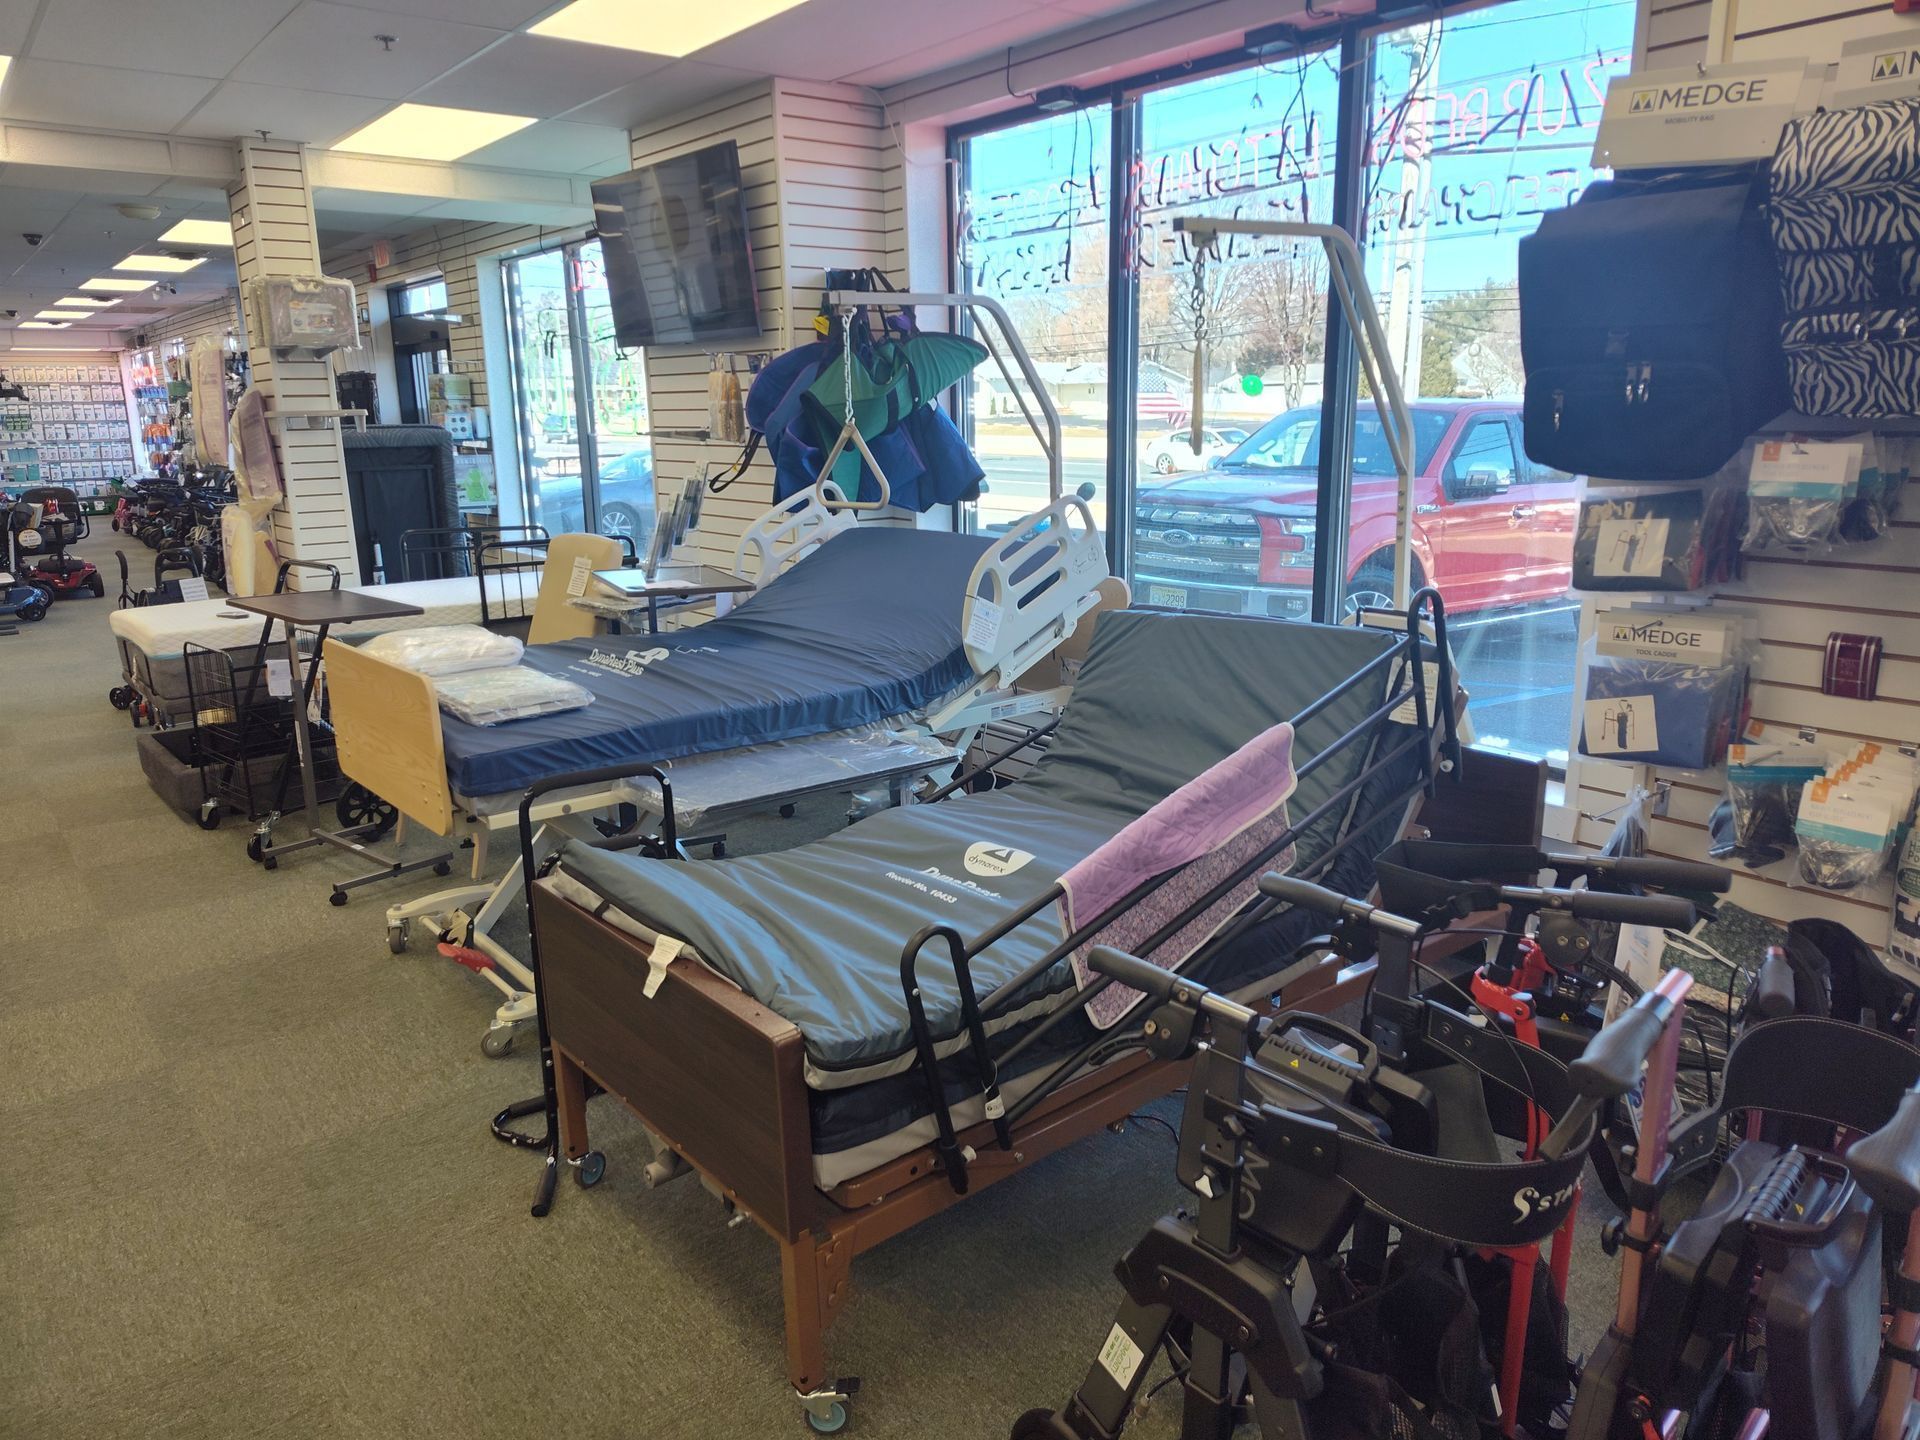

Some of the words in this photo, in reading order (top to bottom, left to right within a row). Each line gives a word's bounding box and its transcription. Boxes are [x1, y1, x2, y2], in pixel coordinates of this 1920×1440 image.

[1659, 79, 1767, 110] MEDGE
[1632, 628, 1702, 647] MEDGE
[1636, 648, 1652, 656] TOOL
[1654, 650, 1678, 658] CADDIE
[623, 660, 645, 676] Plus
[968, 854, 1007, 874] dynarex
